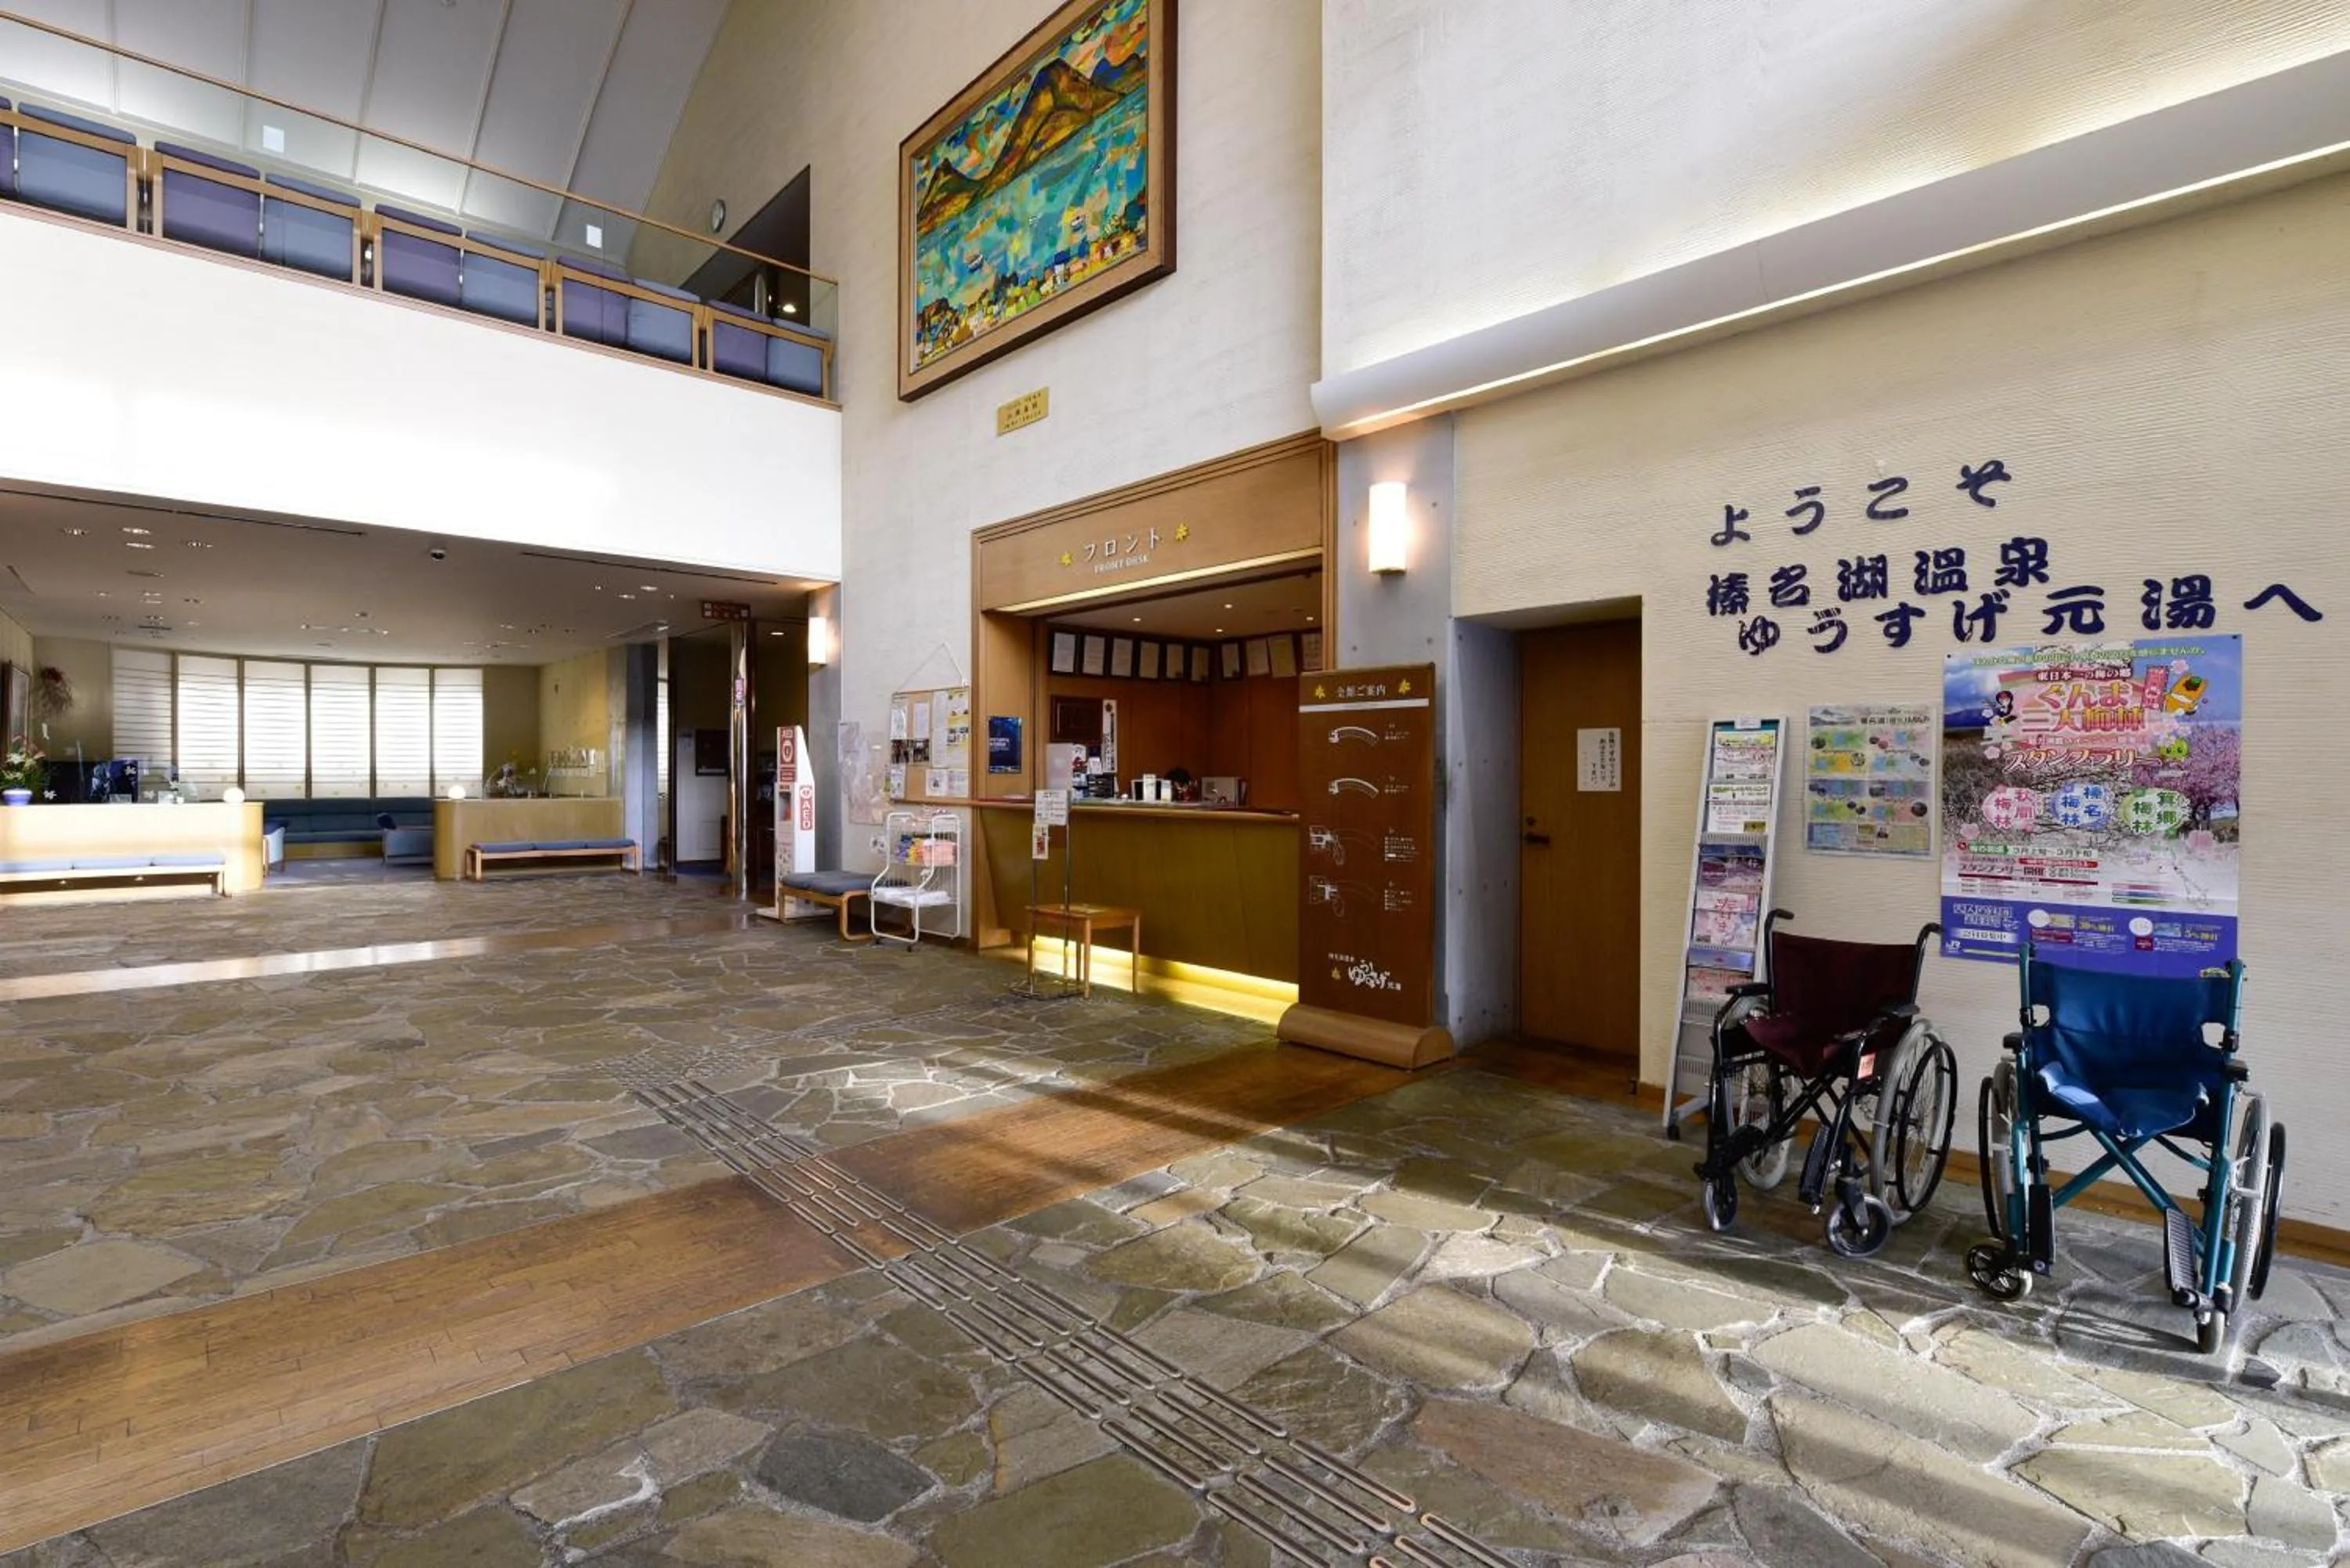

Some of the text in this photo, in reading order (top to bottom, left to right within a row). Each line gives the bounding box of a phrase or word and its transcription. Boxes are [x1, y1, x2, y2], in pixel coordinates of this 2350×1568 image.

[1710, 460, 2012, 547] ようこそ
[1084, 528, 1159, 562] フロント
[1706, 537, 2050, 616] 榛名湖温泉
[1738, 574, 2323, 656] ゆうすげ元湯へ
[2038, 682, 2129, 709] ぐんま
[2003, 748, 2163, 774] スタンプラリー
[801, 800, 812, 829] AED
[2061, 793, 2081, 826] 梅林
